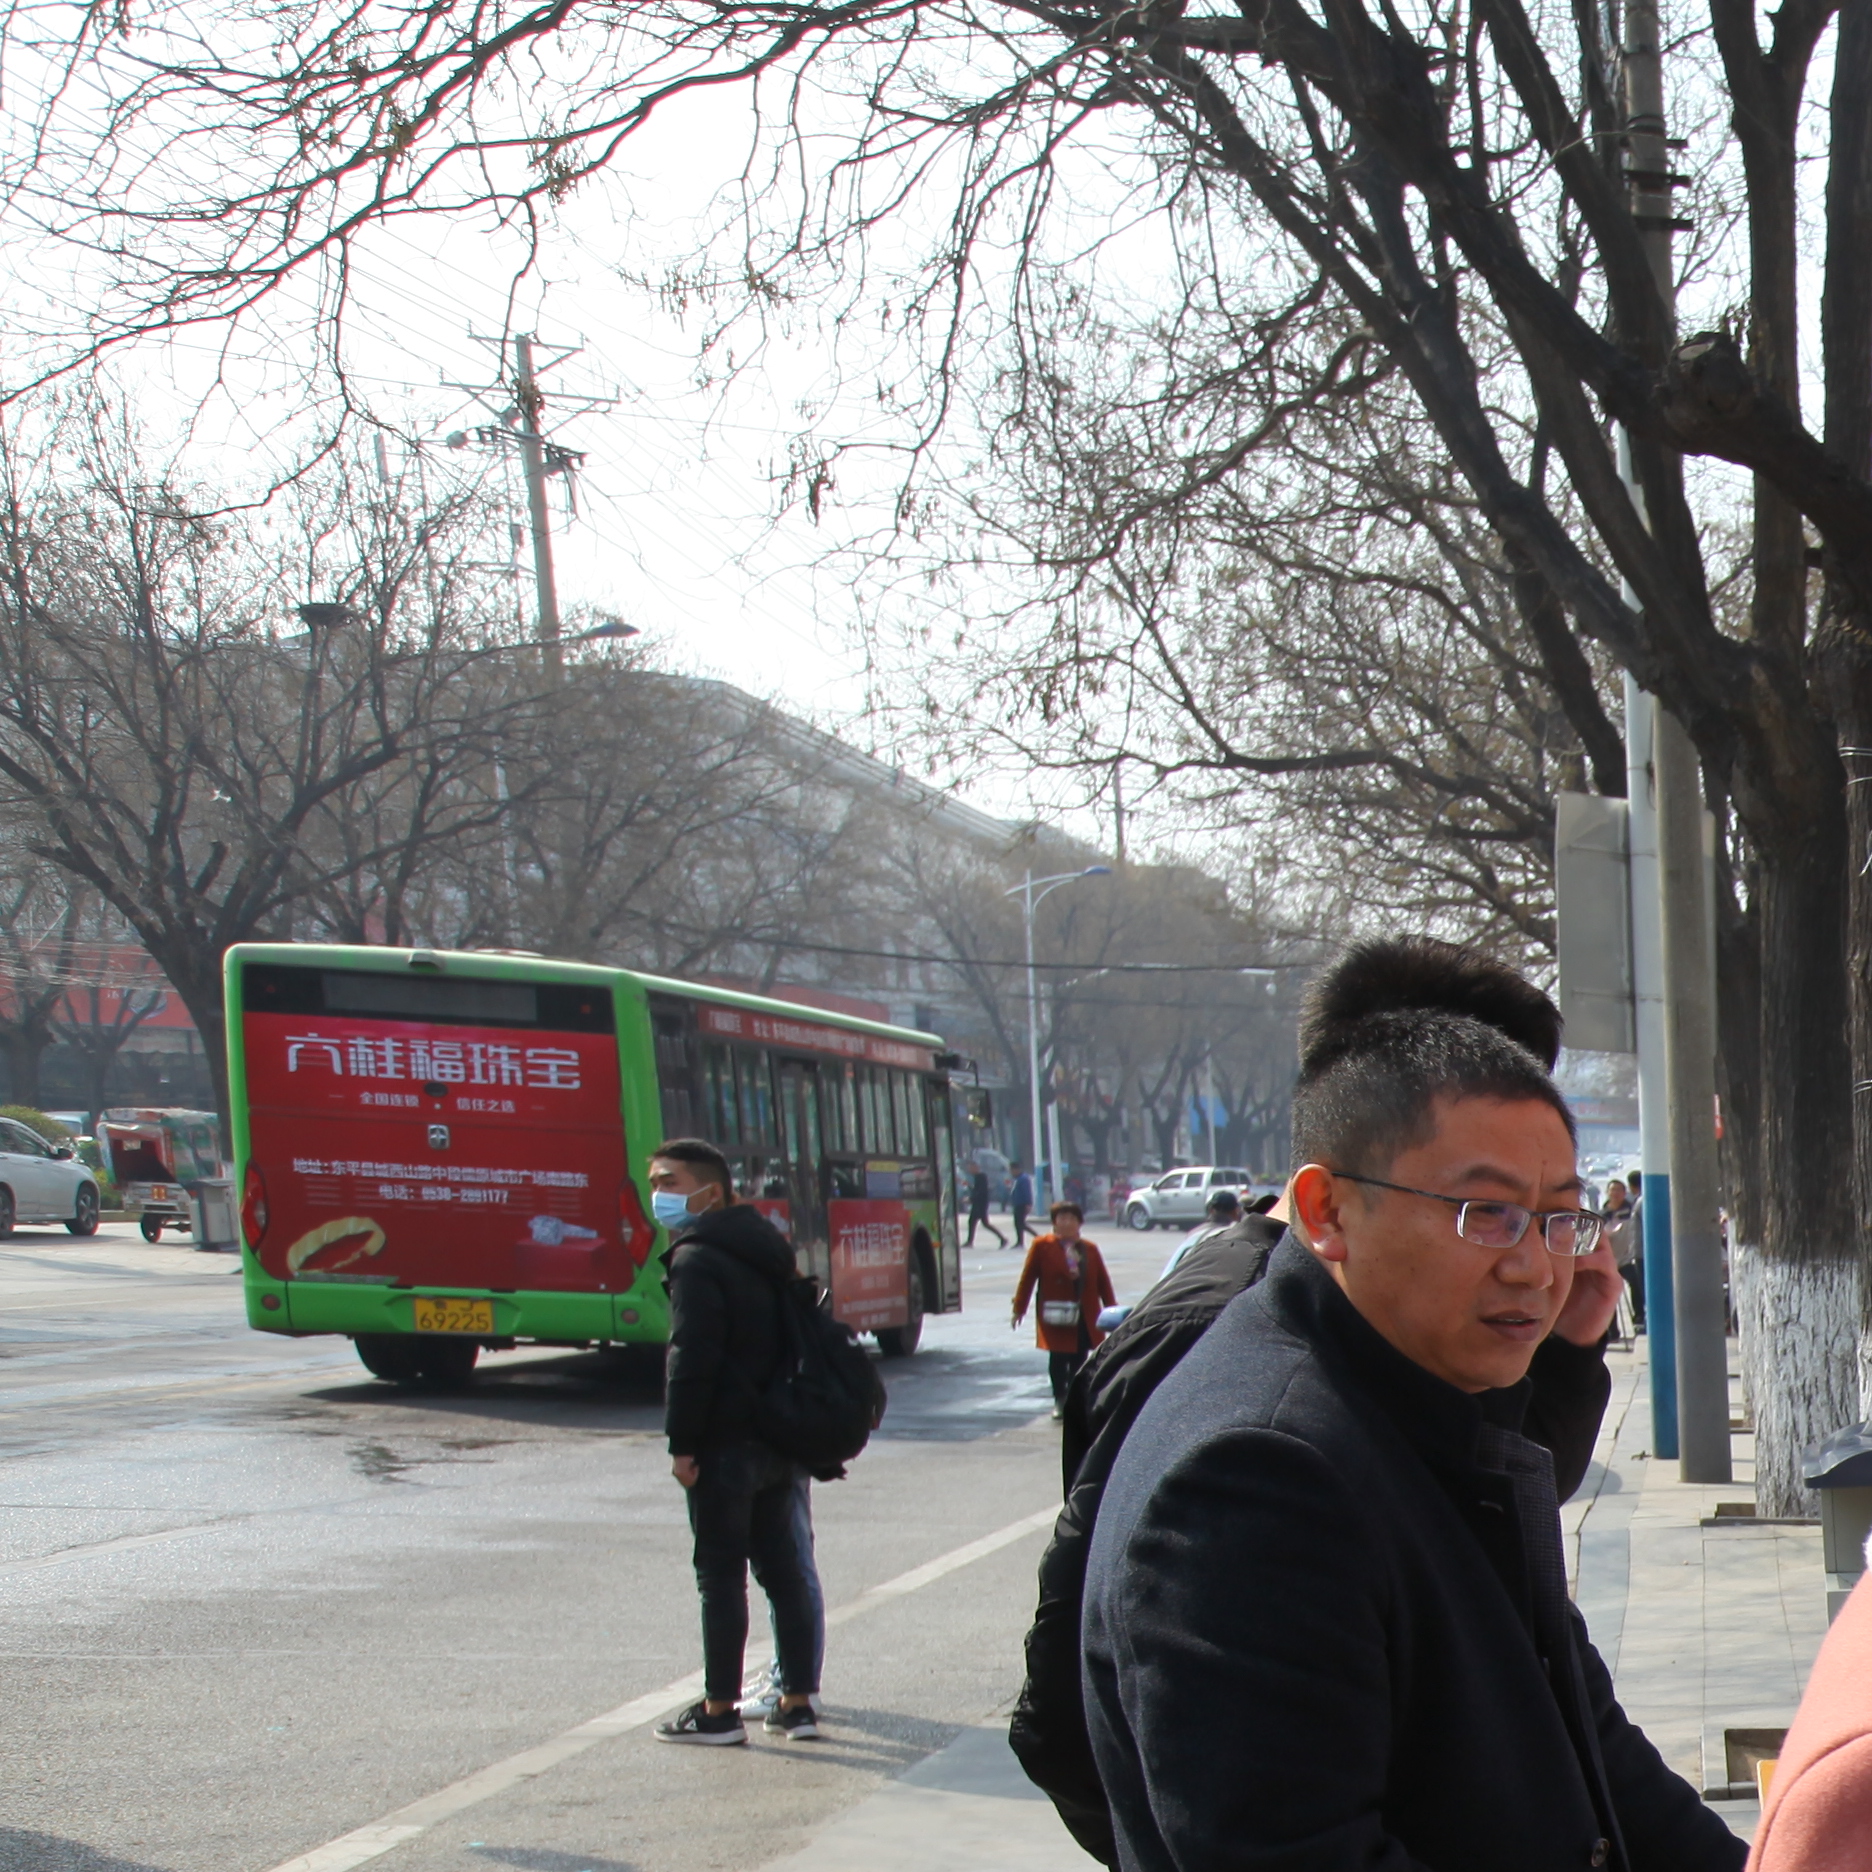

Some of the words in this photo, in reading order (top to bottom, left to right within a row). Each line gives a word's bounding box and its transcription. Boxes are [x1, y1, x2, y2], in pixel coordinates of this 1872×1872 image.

[284, 1031, 582, 1091] 六桂福珠宝
[359, 1091, 420, 1108] 全国连锁
[456, 1097, 516, 1114] 信任之选
[419, 1311, 490, 1332] 69225
